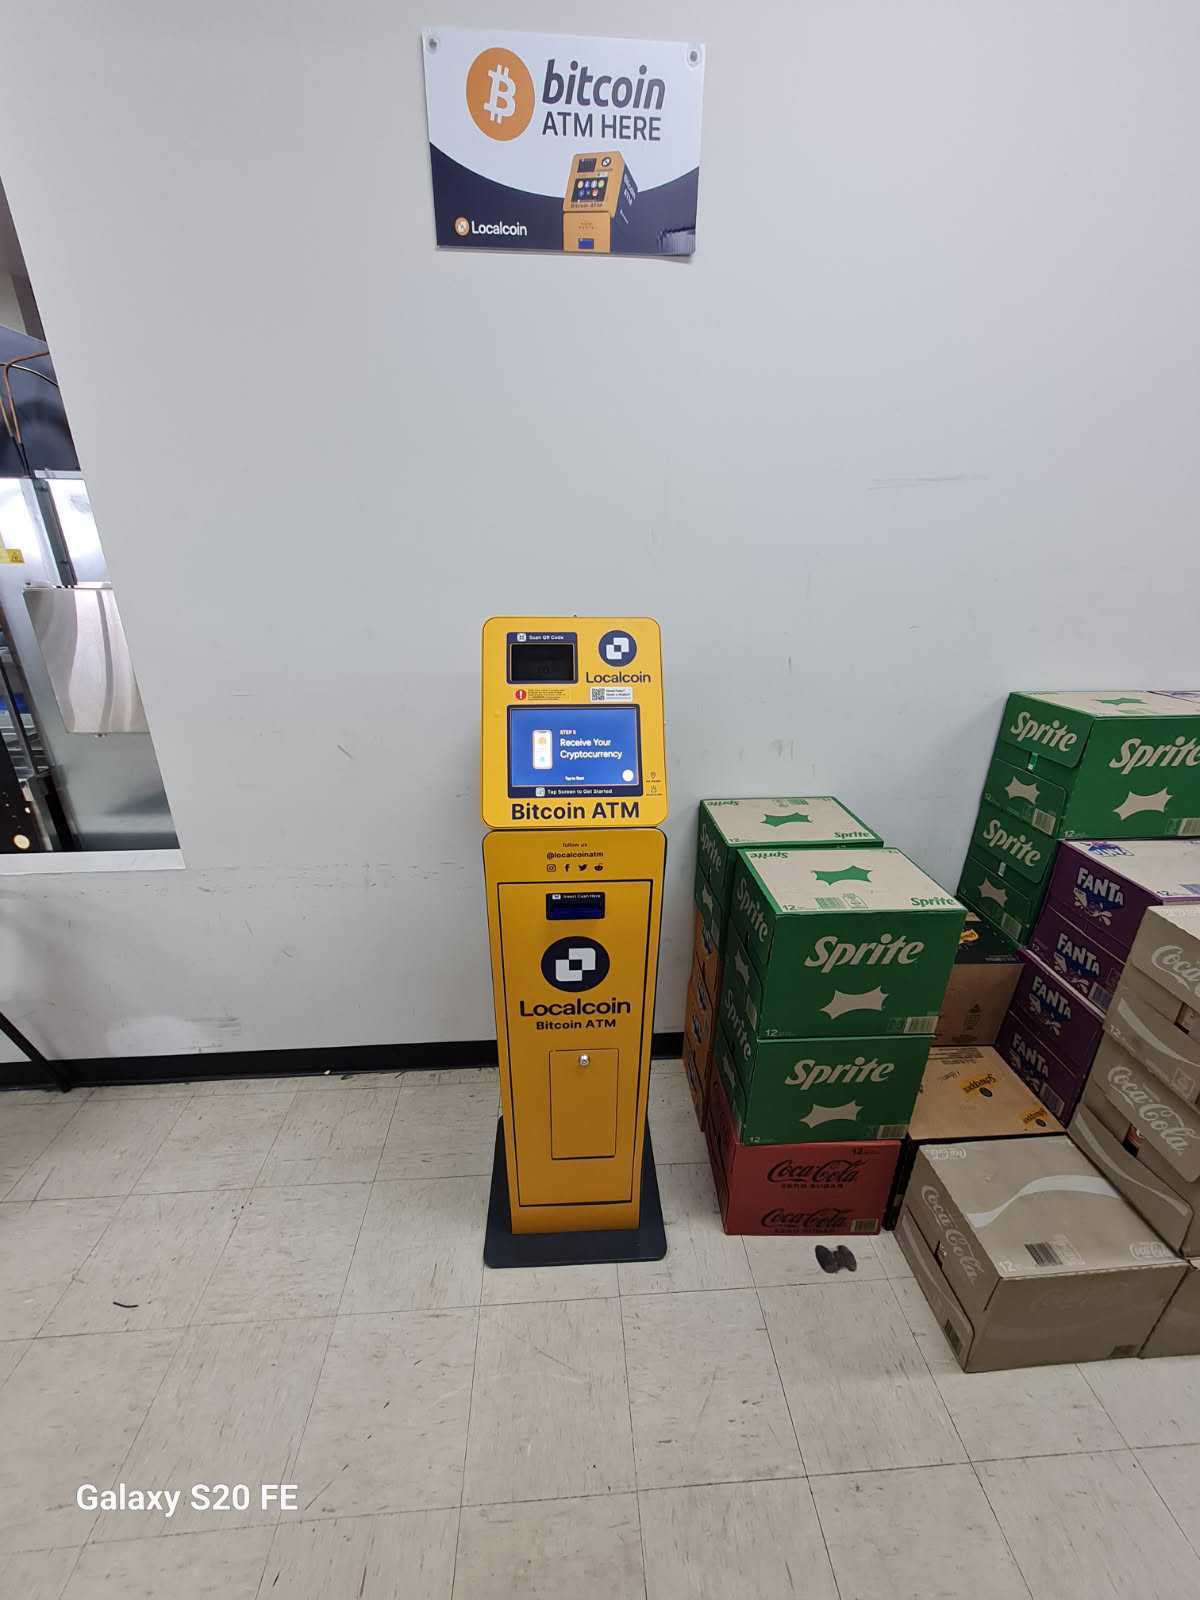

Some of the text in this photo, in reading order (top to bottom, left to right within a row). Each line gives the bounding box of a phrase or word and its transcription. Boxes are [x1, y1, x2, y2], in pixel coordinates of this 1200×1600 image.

[542, 58, 666, 110] bitcoin
[542, 111, 662, 142] ATM HERE
[471, 219, 528, 237] Localcoin
[585, 670, 652, 684] Localcoin
[560, 738, 611, 747] Receive Your
[1009, 711, 1079, 753] Sprite
[560, 750, 623, 760] Cryptocurrency
[1108, 735, 1200, 775] Sprite
[511, 801, 640, 820] Bitcoin ATM
[833, 831, 870, 839] Sprite
[982, 818, 1041, 867] Sprite
[546, 851, 604, 860] @localcoinatm
[910, 896, 956, 908] Sprite
[1076, 867, 1124, 906] FANTA
[737, 876, 769, 943] Sprite
[803, 933, 925, 974] Sprite
[1056, 932, 1100, 976] FANTA
[519, 997, 631, 1017] Localcoin
[1032, 975, 1072, 1019] FANTA
[536, 1018, 616, 1031] Bitcoin ATM
[724, 989, 751, 1062] Sprite
[784, 1056, 896, 1091] Sprite
